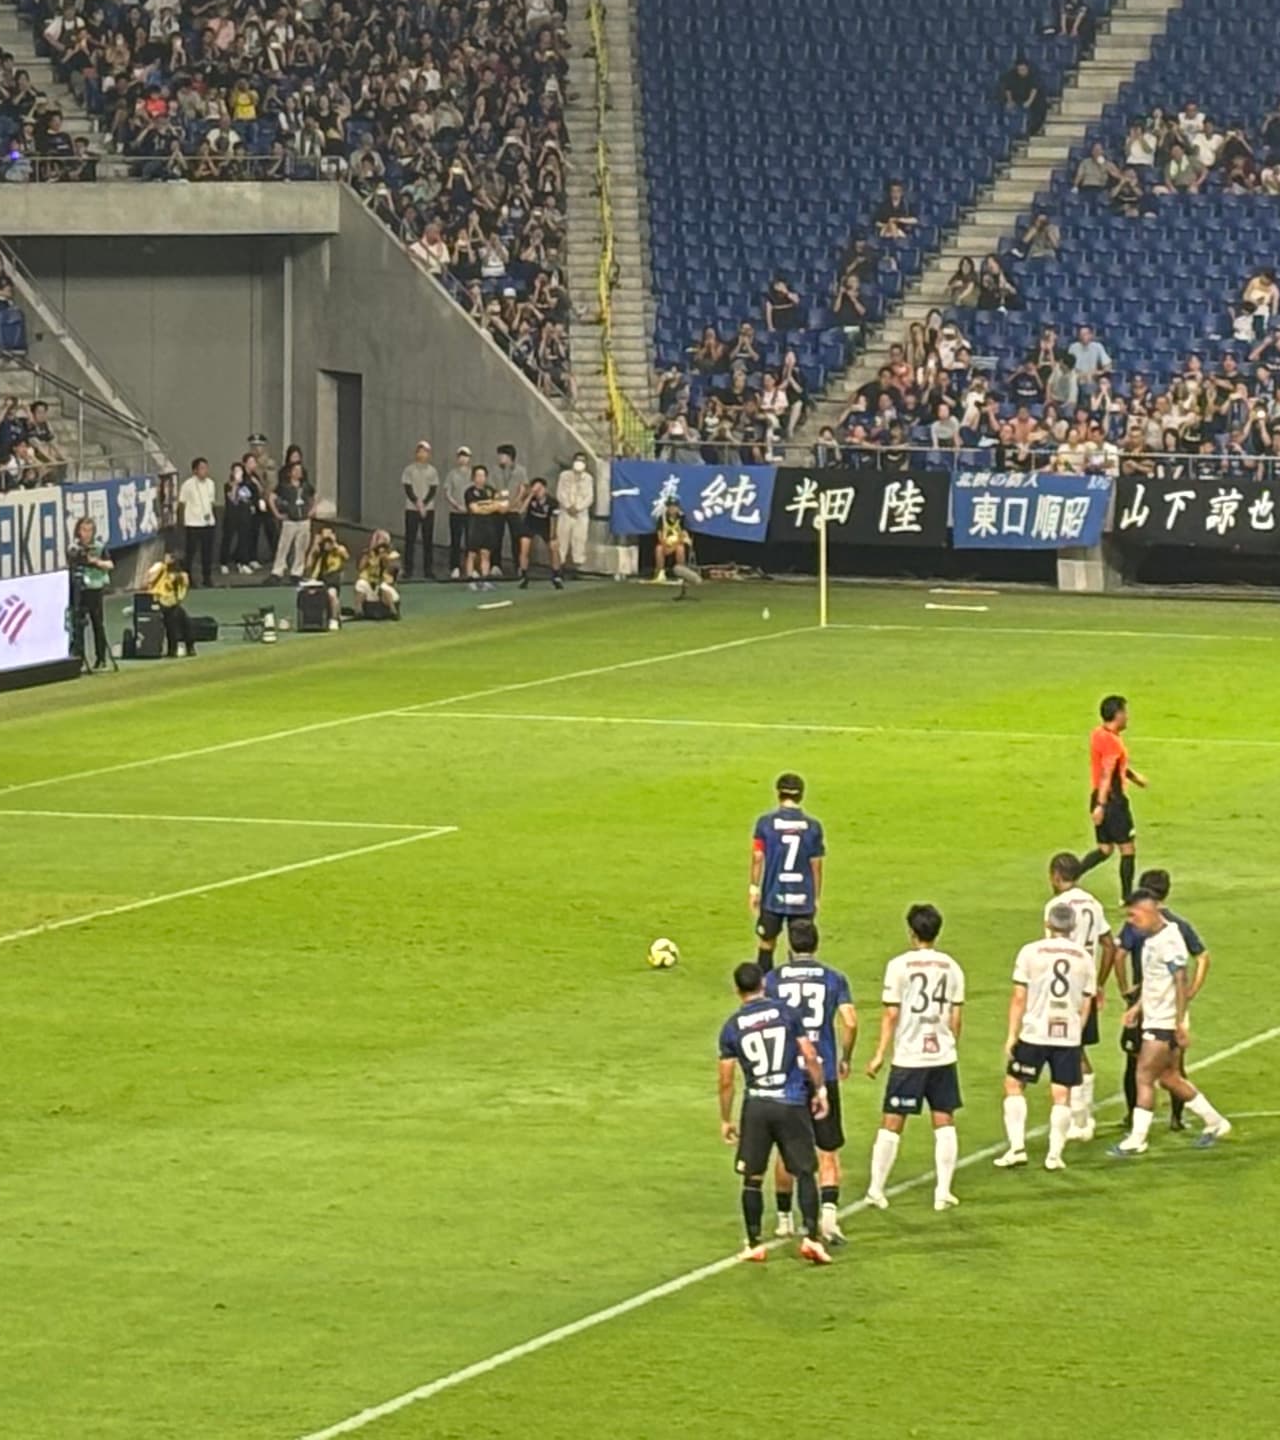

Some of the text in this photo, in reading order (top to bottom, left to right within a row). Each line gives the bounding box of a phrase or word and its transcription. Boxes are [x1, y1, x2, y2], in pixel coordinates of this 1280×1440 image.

[968, 491, 1091, 541] 東口順昭
[781, 834, 801, 871] 7
[909, 972, 948, 1014] 34
[1050, 958, 1070, 998] 8
[741, 1026, 787, 1076] 97
